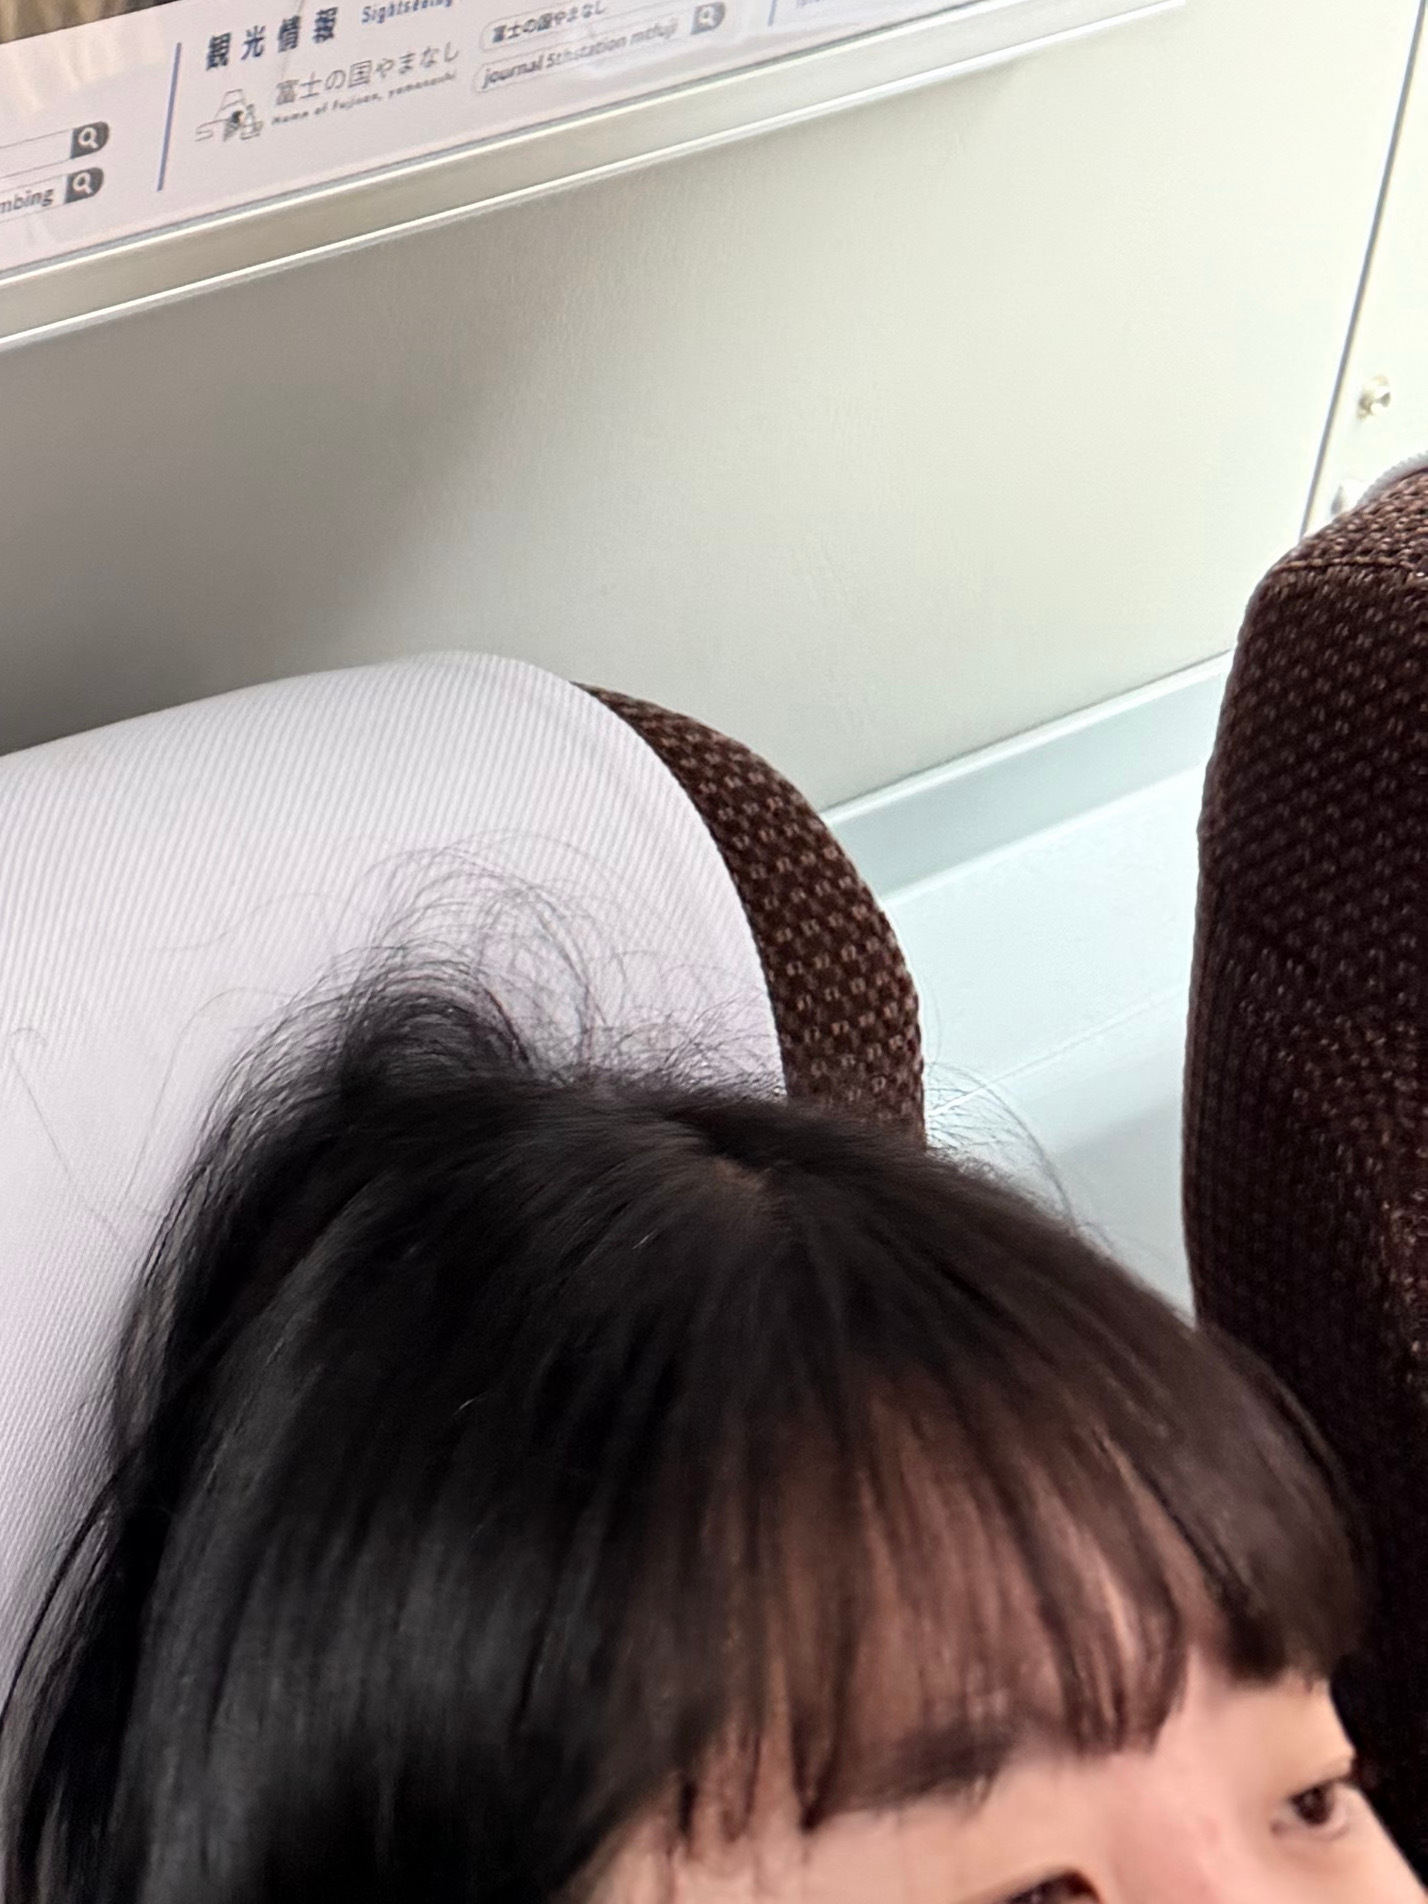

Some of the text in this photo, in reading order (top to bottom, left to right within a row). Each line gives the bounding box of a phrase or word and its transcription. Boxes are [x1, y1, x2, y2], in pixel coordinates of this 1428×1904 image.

[275, 41, 459, 106] 富士の国やまなし
